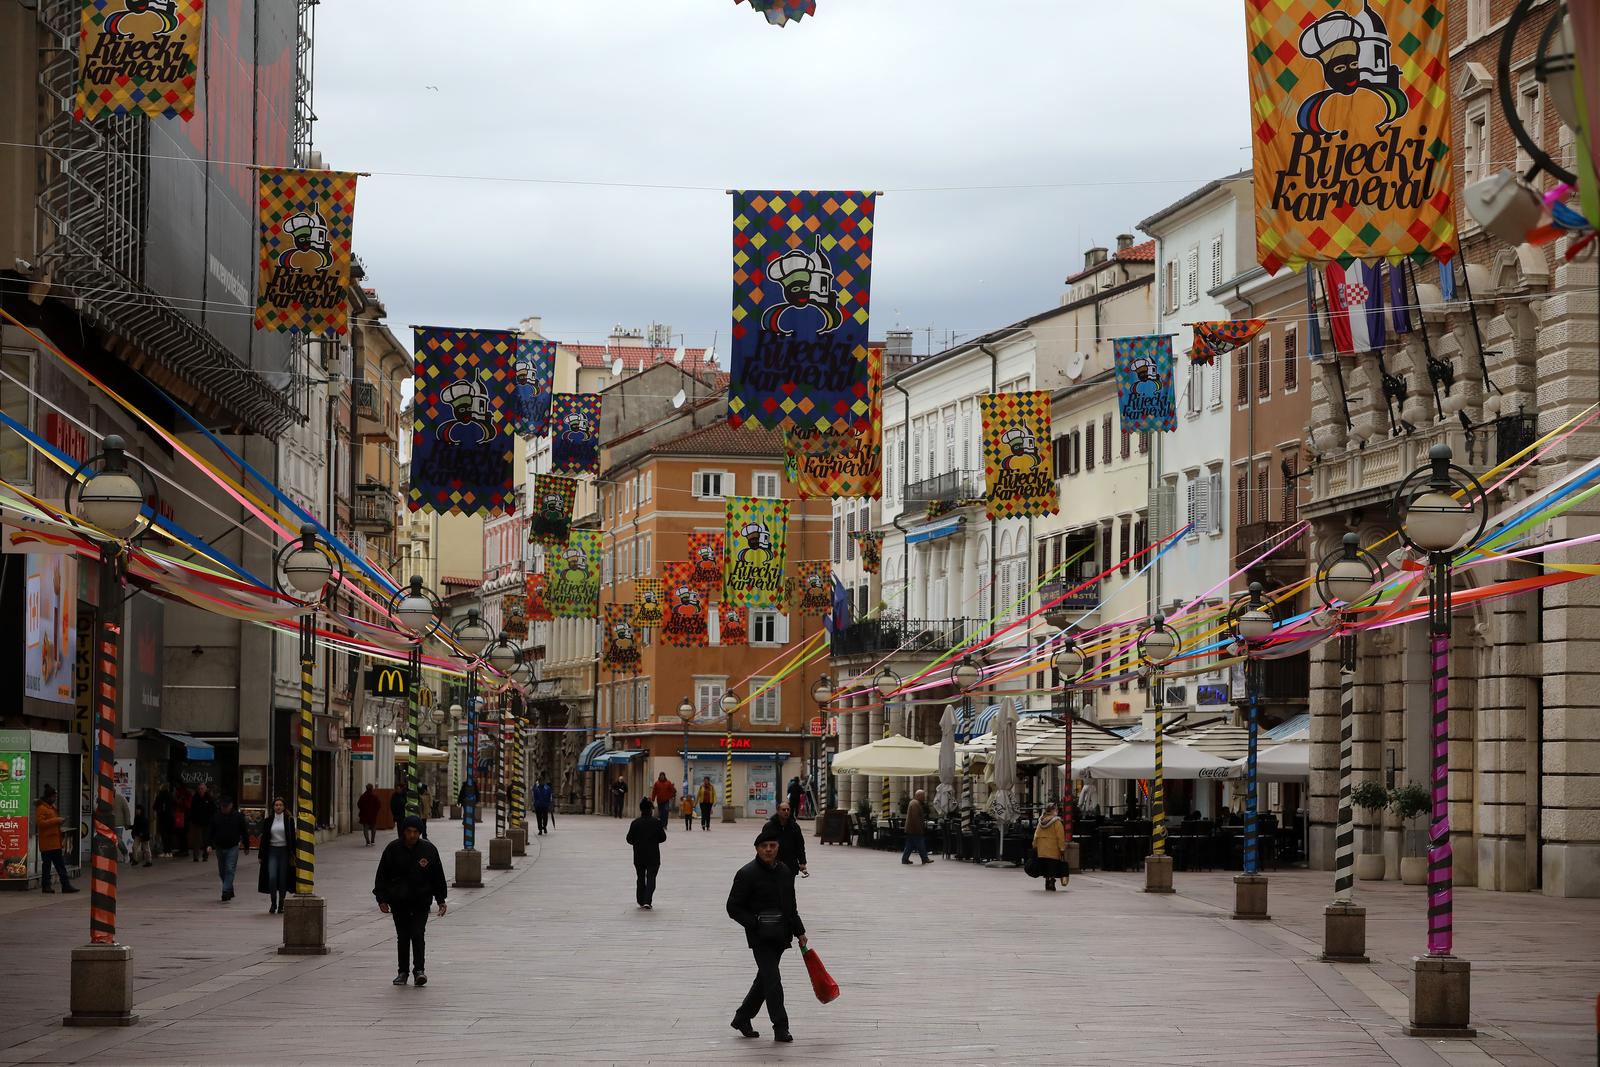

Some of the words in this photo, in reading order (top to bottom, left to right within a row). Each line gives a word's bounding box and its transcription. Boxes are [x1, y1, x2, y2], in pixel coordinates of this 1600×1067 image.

[83, 54, 189, 85] karneval
[1286, 125, 1429, 190] Riječki
[1272, 158, 1436, 222] karneval
[264, 282, 344, 308] karneval
[1122, 401, 1171, 419] karneval
[804, 453, 875, 478] karneval
[991, 479, 1052, 500] karneval
[727, 573, 781, 591] karneval
[76, 616, 91, 697] OTKUP
[720, 737, 751, 748] TISAK
[0, 800, 18, 809] Grill
